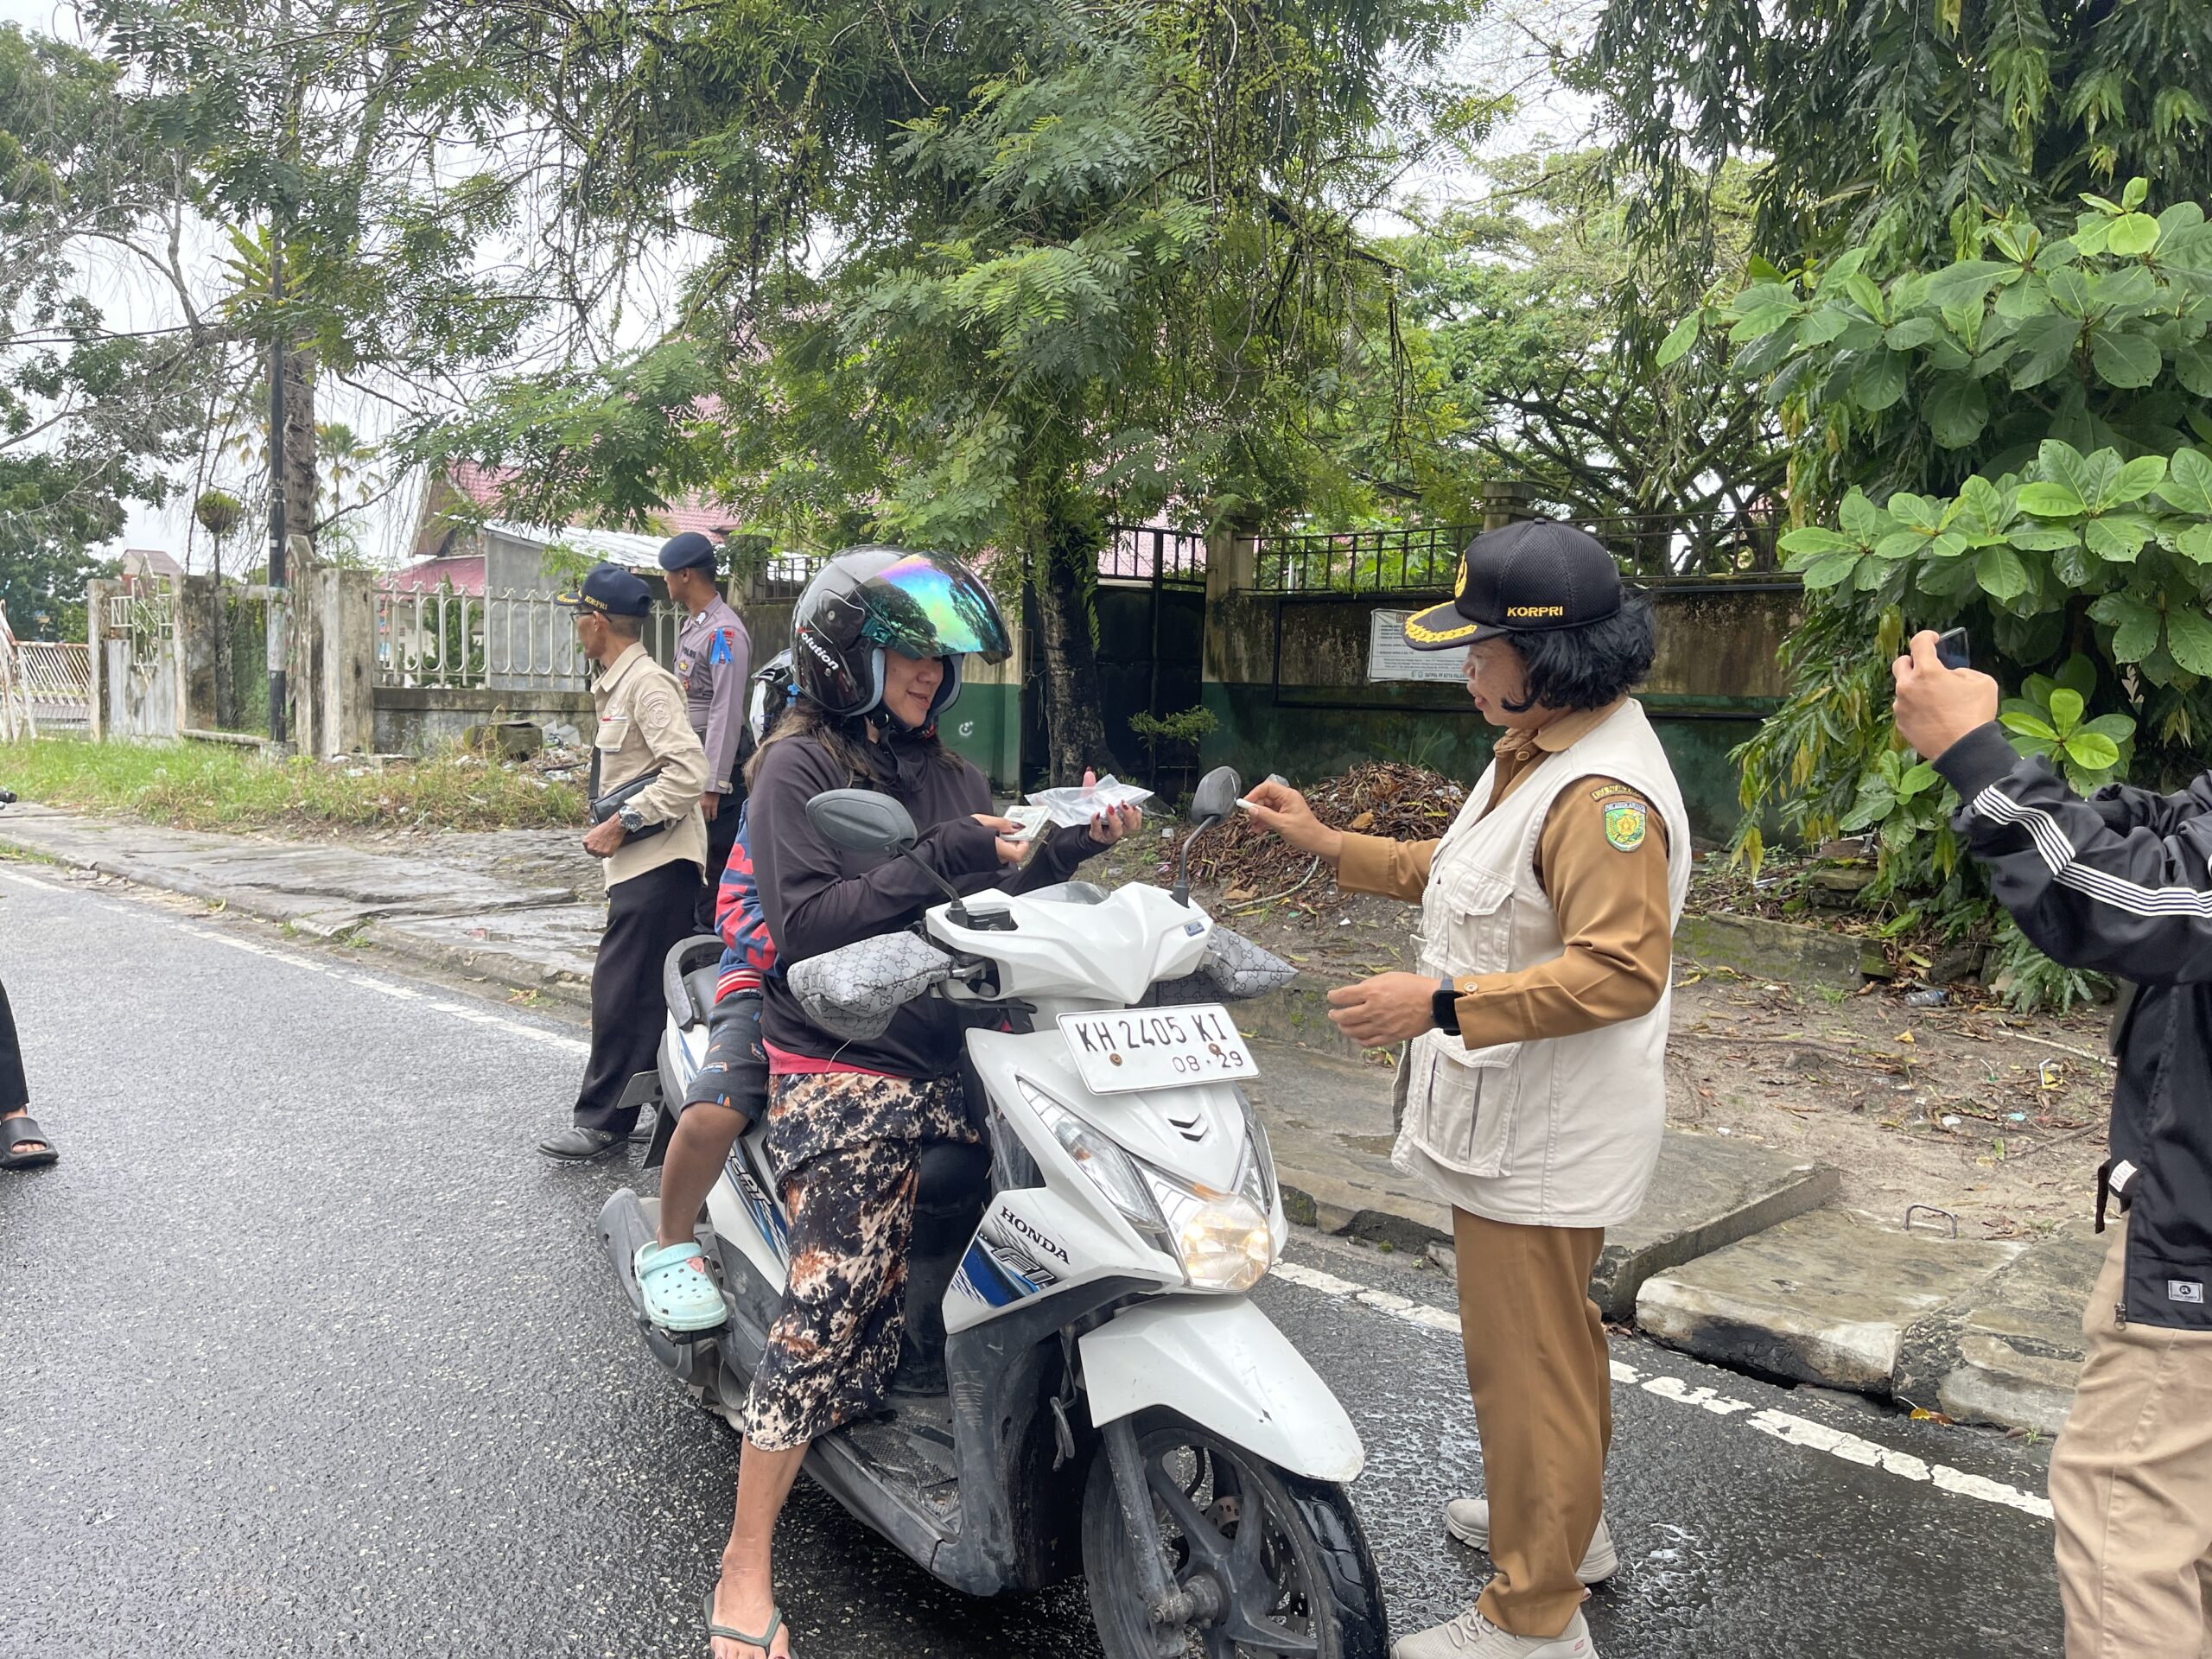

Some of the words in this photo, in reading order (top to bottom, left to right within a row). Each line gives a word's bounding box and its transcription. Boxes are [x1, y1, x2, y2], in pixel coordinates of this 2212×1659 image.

[584, 594, 608, 610] KORPRI
[1506, 606, 1563, 617] KORPRI
[1076, 1021, 1116, 1052] KH
[1119, 1016, 1187, 1048] 2405
[1192, 1013, 1228, 1042] KI
[1000, 1205, 1071, 1265] HONDA
